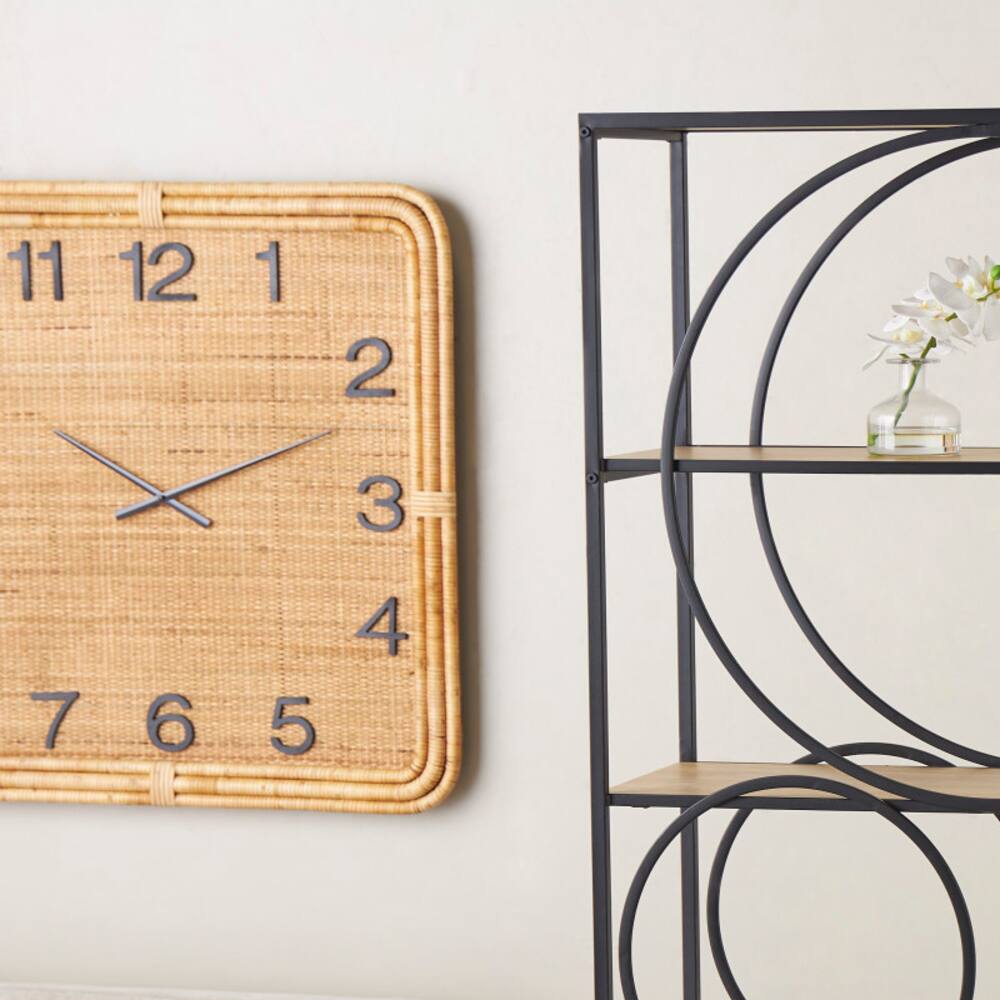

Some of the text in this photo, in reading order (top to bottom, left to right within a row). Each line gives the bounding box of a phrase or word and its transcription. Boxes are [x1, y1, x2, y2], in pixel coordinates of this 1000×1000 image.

[8, 240, 64, 302] 11
[119, 241, 198, 302] 12
[255, 241, 281, 302] 1
[344, 337, 397, 398] 2
[356, 475, 405, 532] 3
[353, 596, 410, 657] 4
[30, 691, 80, 750] 7
[146, 693, 196, 753] 6
[270, 696, 316, 756] 5
